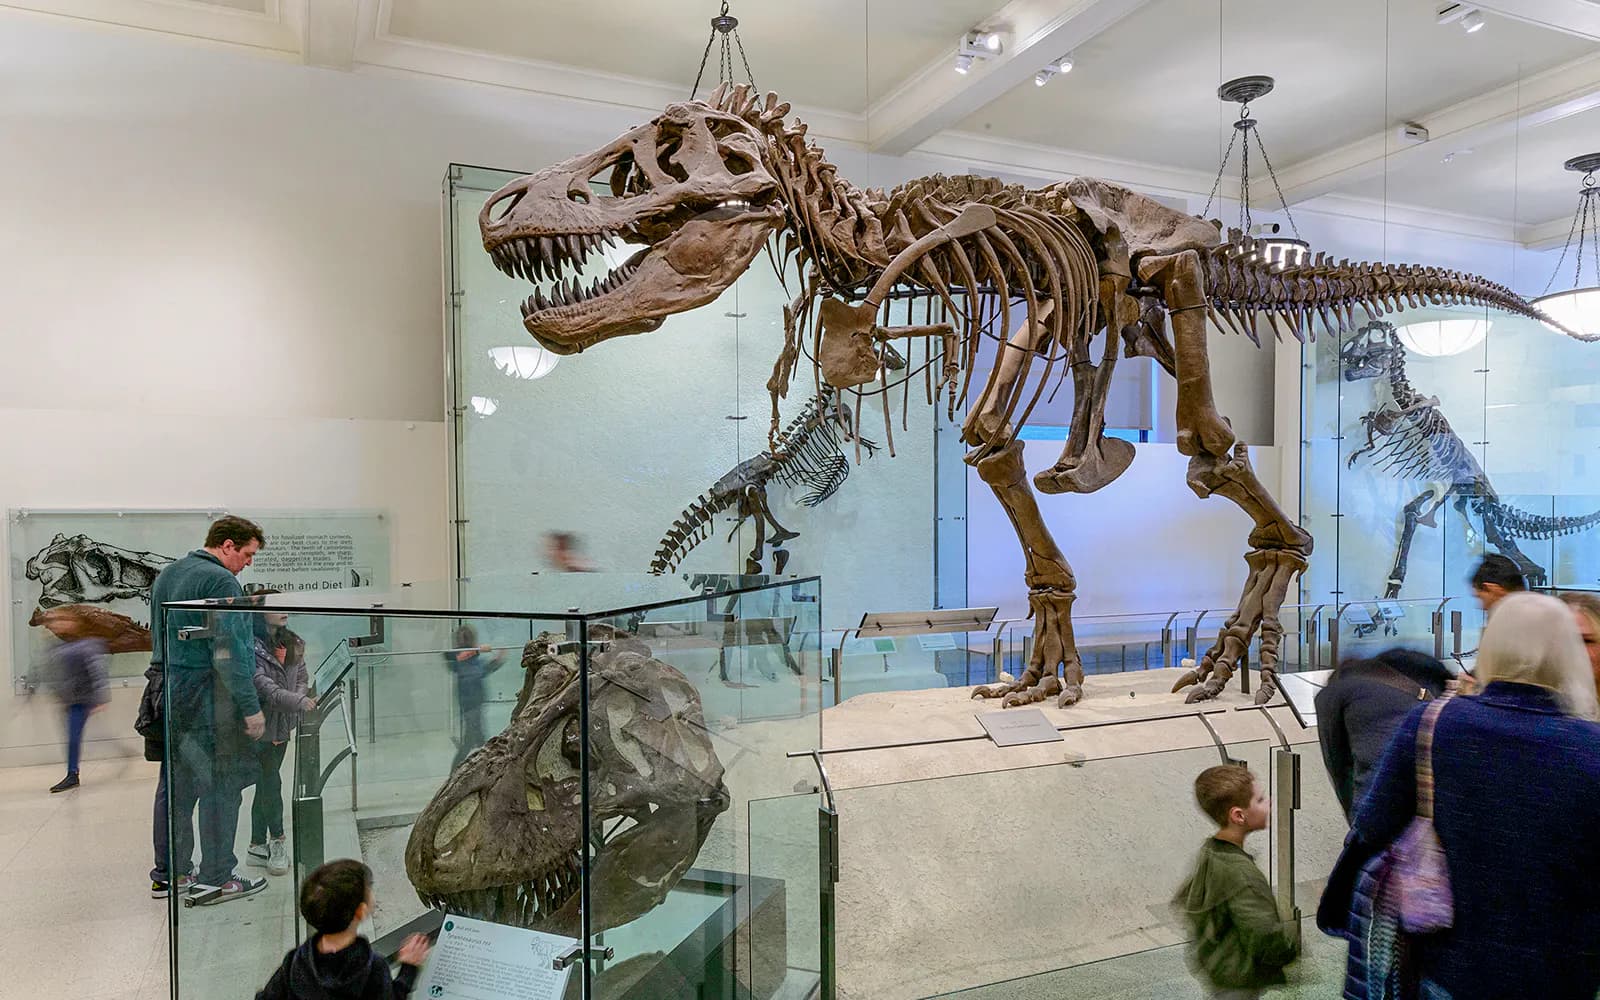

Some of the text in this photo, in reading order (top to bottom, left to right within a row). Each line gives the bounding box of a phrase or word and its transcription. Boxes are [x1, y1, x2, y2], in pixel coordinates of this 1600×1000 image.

[266, 581, 342, 590] Teeth and Diet
